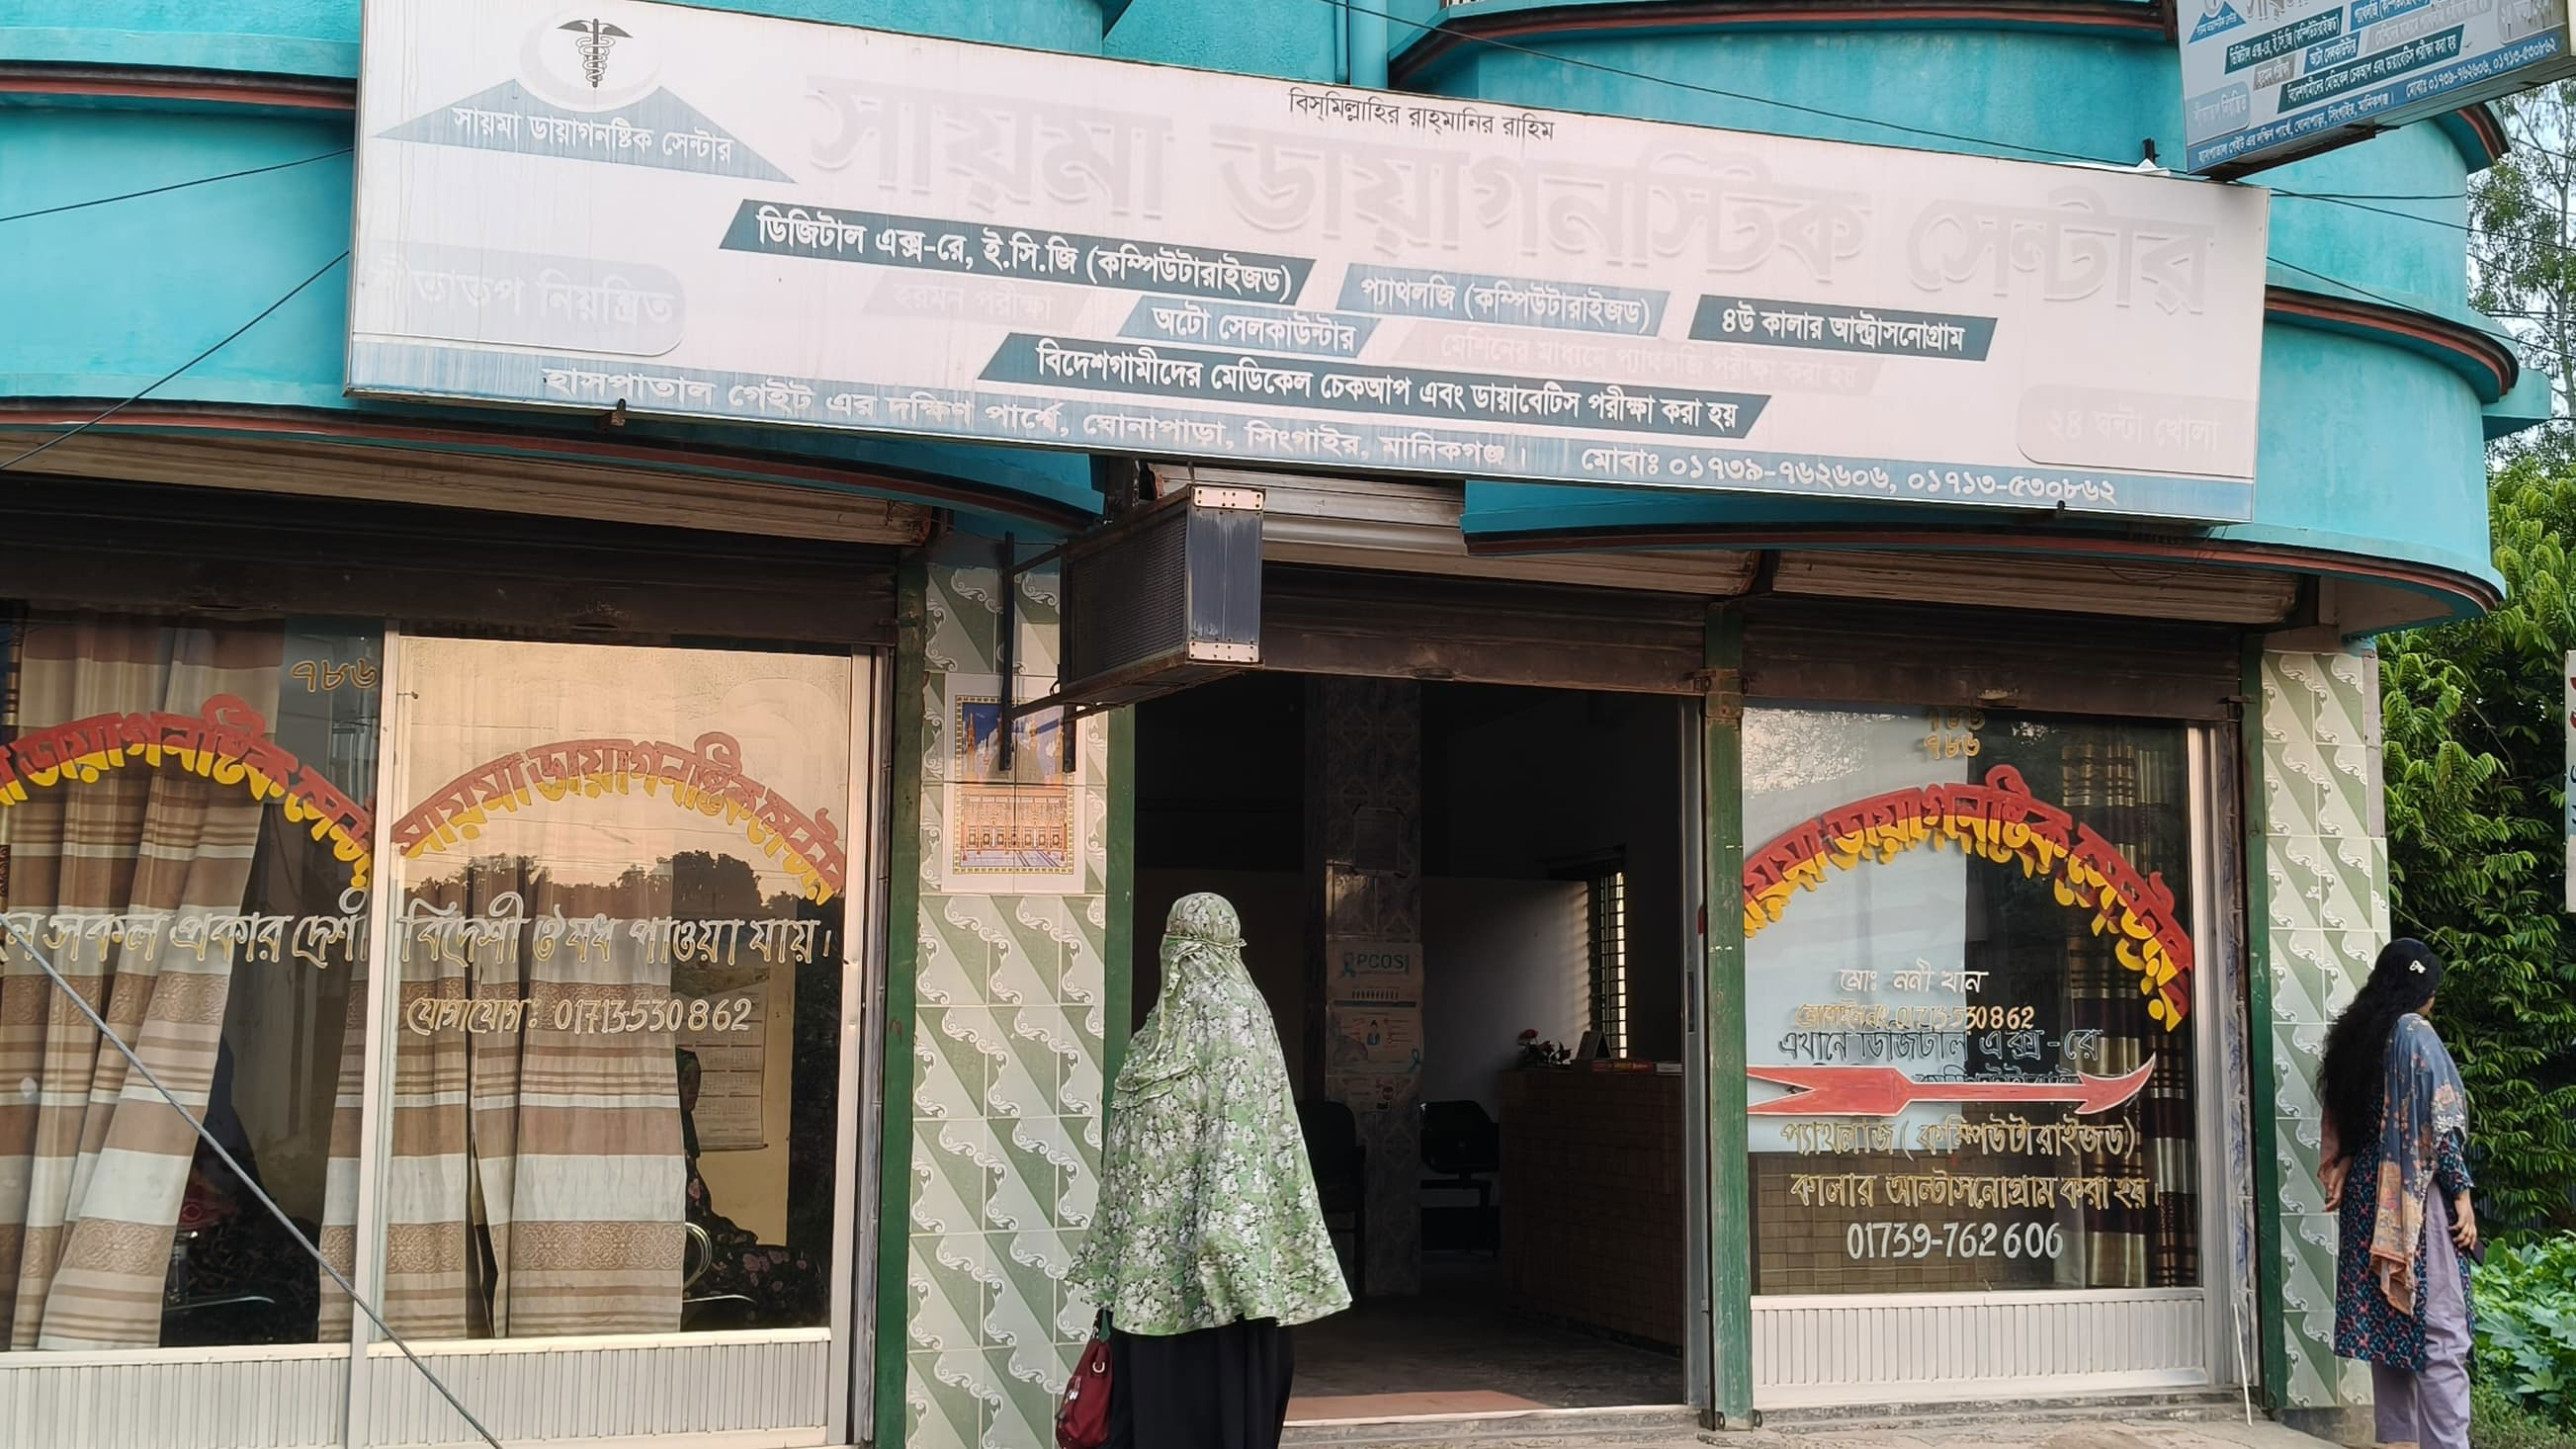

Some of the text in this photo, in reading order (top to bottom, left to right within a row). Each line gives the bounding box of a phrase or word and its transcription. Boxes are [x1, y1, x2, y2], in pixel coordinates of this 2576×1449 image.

[451, 106, 522, 141] সায়মা
[662, 127, 735, 165] সেন্টার
[1503, 113, 1555, 140] রাহিম
[756, 205, 1292, 303] ডিজিটাল এক্স-রে, ই.সি.জি (কম্পিউটারাইজড)
[1151, 300, 1359, 354] অটো সেলকাউন্টার
[1360, 274, 1651, 335] প্যাথলজি (কম্পিউটারাইজড)
[1760, 309, 1826, 341] কালার
[1036, 338, 1739, 432] বিদেশগামীদের মেডিকেল চেকআপ এবং ডায়াবেটিস পরীক্ষা করা হয়
[542, 367, 717, 406] হাসপাতাল
[728, 378, 816, 415] গেইট
[825, 392, 878, 419] এর
[884, 390, 975, 428] দক্ষিণ
[1907, 469, 2117, 506] ০১৭১৩-৫৩০৮৬২
[43, 911, 175, 963] সকল
[168, 911, 296, 963] প্রকার
[293, 886, 370, 970] দেশী
[397, 892, 532, 968] বিদেশী
[1838, 968, 1877, 993] মোঃ
[1790, 1172, 1877, 1208] কালার
[2060, 1175, 2112, 1210] করা
